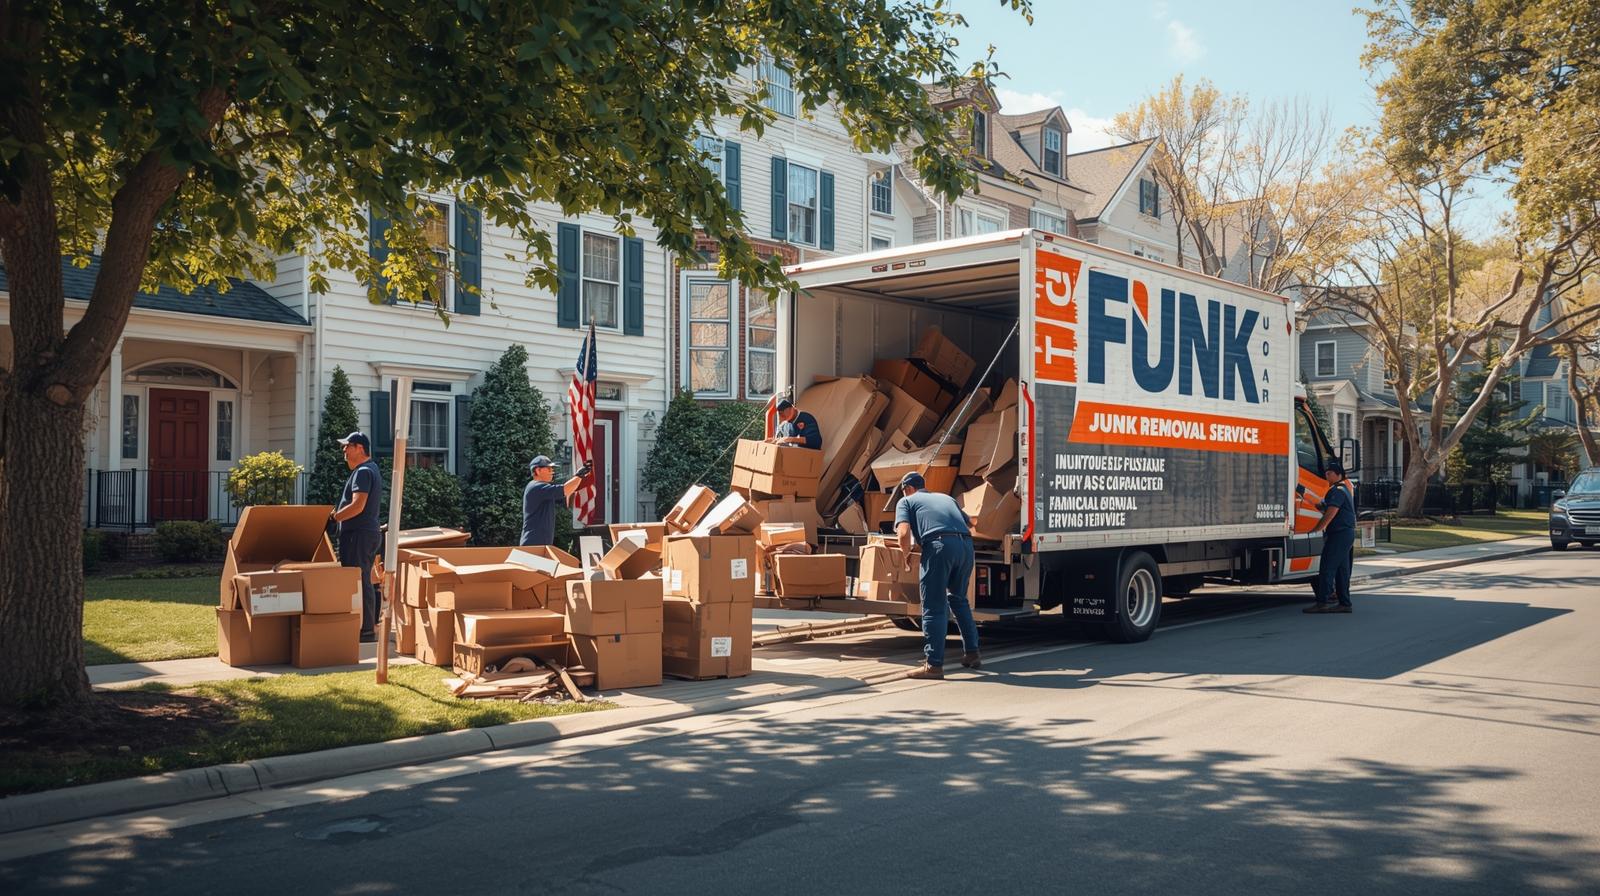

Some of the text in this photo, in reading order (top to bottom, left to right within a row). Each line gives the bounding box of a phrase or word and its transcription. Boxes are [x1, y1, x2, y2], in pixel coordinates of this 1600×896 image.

[1088, 270, 1260, 404] FUNK
[1089, 412, 1260, 444] JUNK REMOVAL SERVICE
